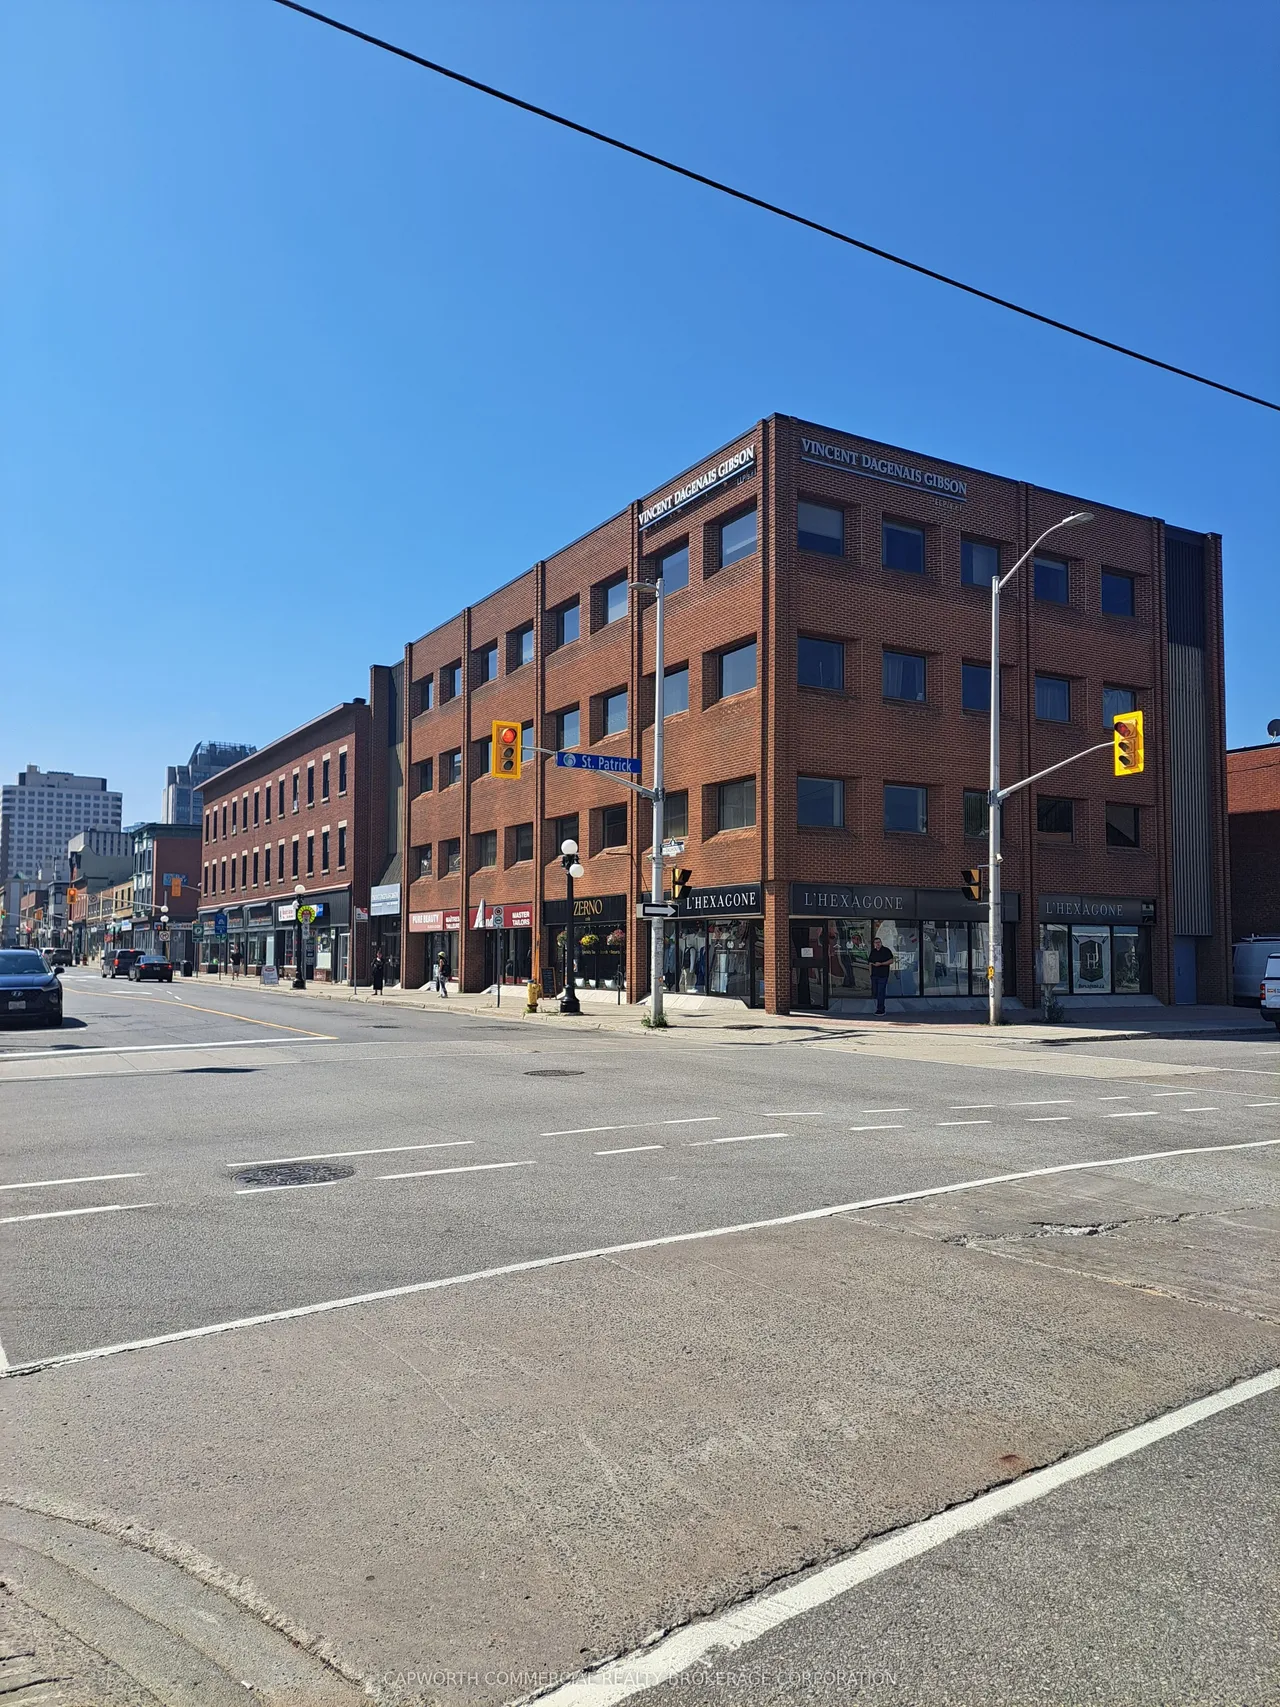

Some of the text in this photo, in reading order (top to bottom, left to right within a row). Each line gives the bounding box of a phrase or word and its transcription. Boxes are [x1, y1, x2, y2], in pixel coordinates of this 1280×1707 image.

[801, 438, 967, 495] VINCENT DAGENAIS GIBSON
[638, 445, 755, 526] VINCENT DAGENAIS GIBSON
[581, 755, 632, 772] St. Patrick
[573, 899, 603, 916] ZERNO
[686, 892, 756, 910] L'HEXAGONE
[804, 892, 903, 910] L'HEXAGONE
[1046, 902, 1124, 916] L'HEXAGONE
[512, 911, 530, 919] MASTER
[512, 918, 530, 926] TAILORS
